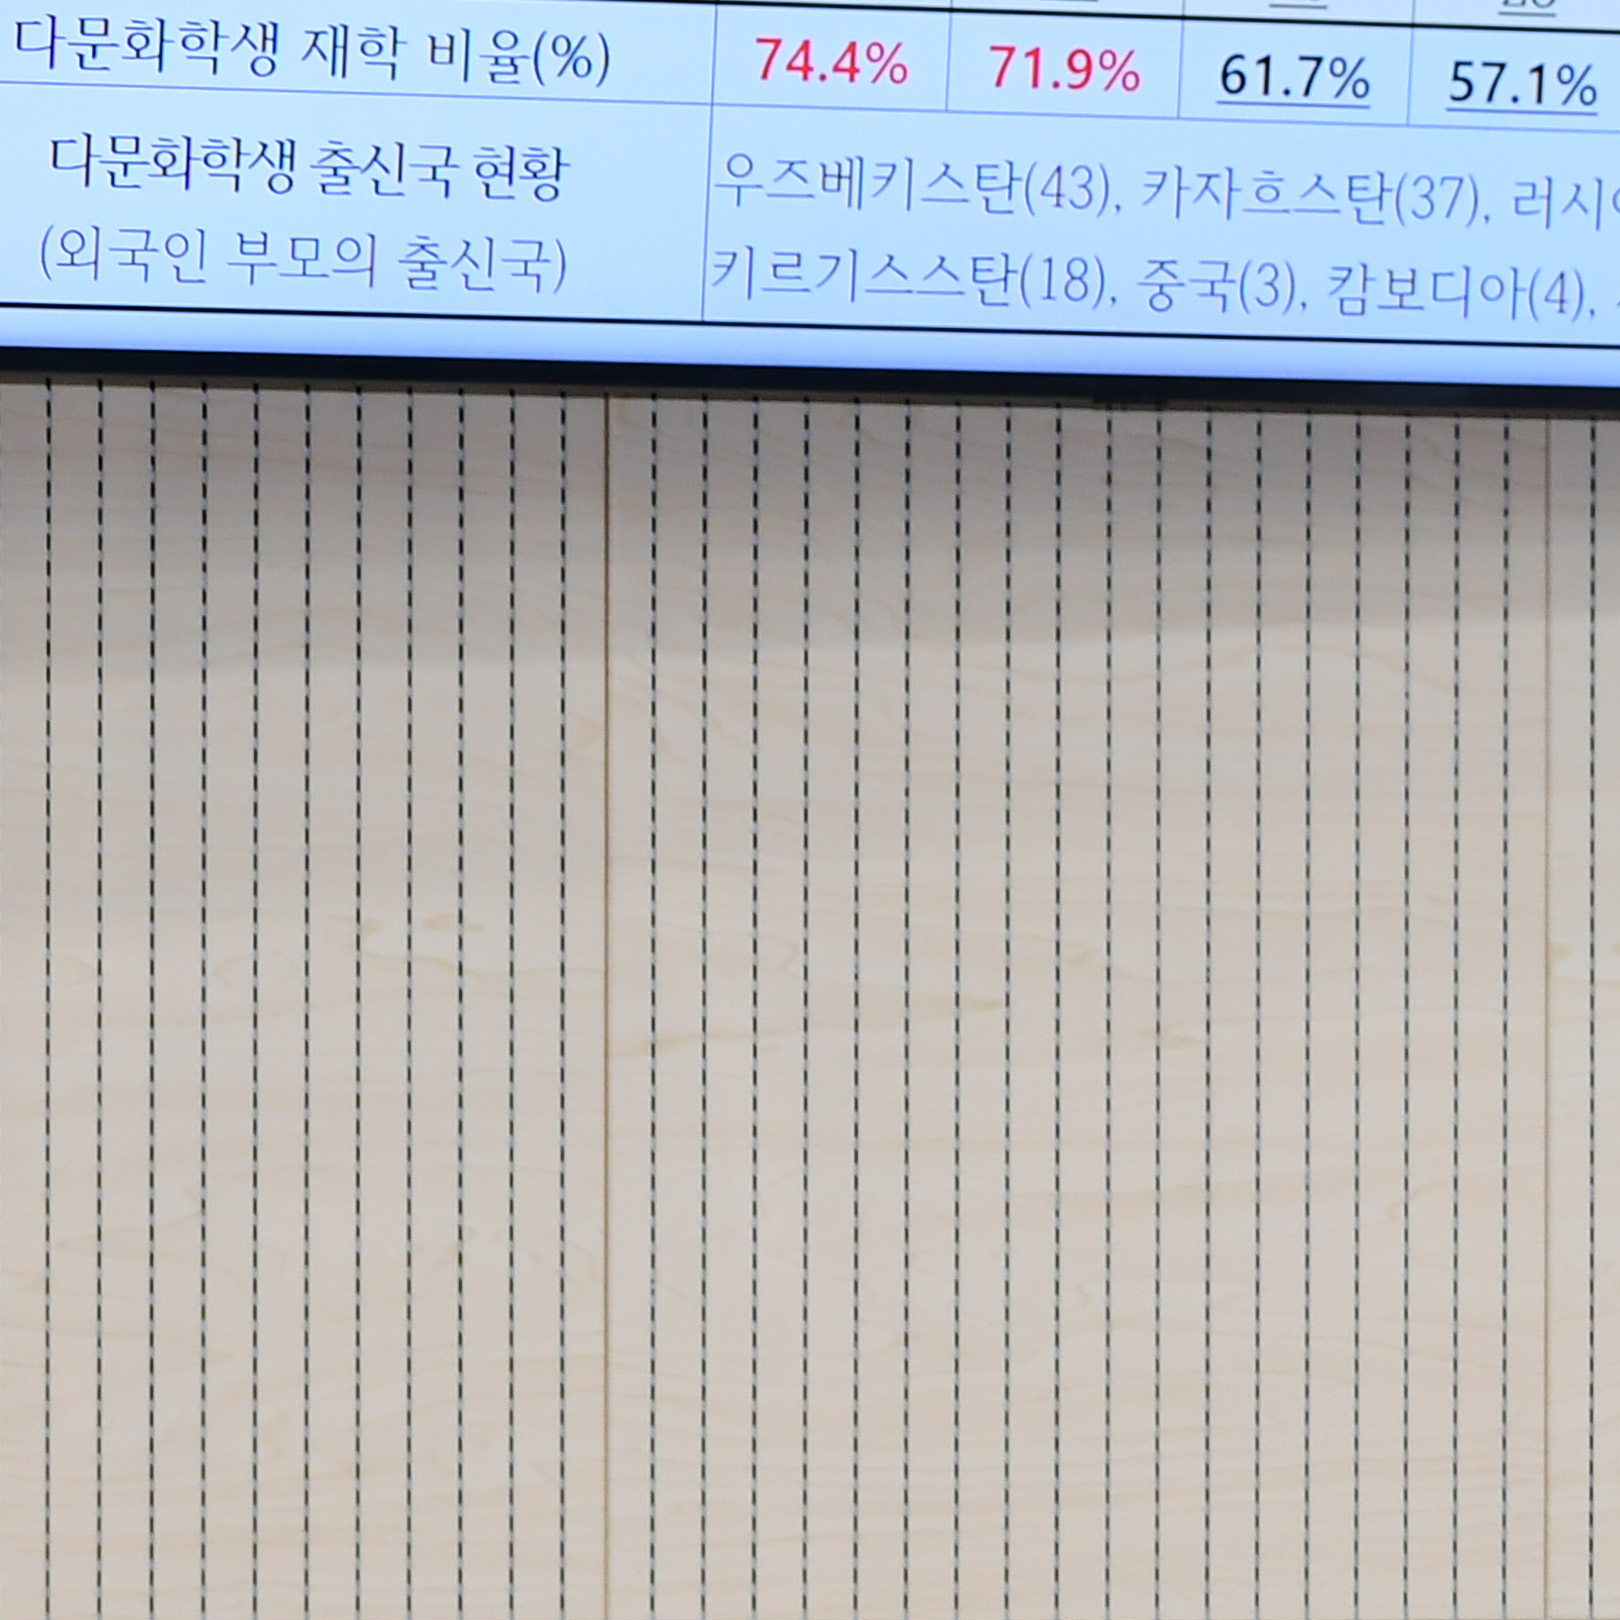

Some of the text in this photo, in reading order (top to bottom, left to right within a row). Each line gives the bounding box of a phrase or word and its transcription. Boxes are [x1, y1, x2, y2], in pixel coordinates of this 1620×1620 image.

[15, 13, 611, 88] 다문화학생 재학 비율(%)
[755, 36, 909, 86] 74.4%
[988, 44, 1141, 93] 71.9%
[1220, 53, 1371, 99] 61.7%
[1449, 60, 1598, 106] 57.1%
[50, 131, 572, 203] 다문화학생 출신국 현황
[714, 152, 1122, 218] 우즈베키스탄(43),
[1142, 164, 1491, 228] 카자흐스탄(37),
[40, 224, 567, 294] (외국인 부모의 출신국)
[712, 244, 1118, 310] 키르기스스탄(18),
[1137, 259, 1308, 315] 중국(3),
[1329, 262, 1596, 322] 캄보디아(4),
